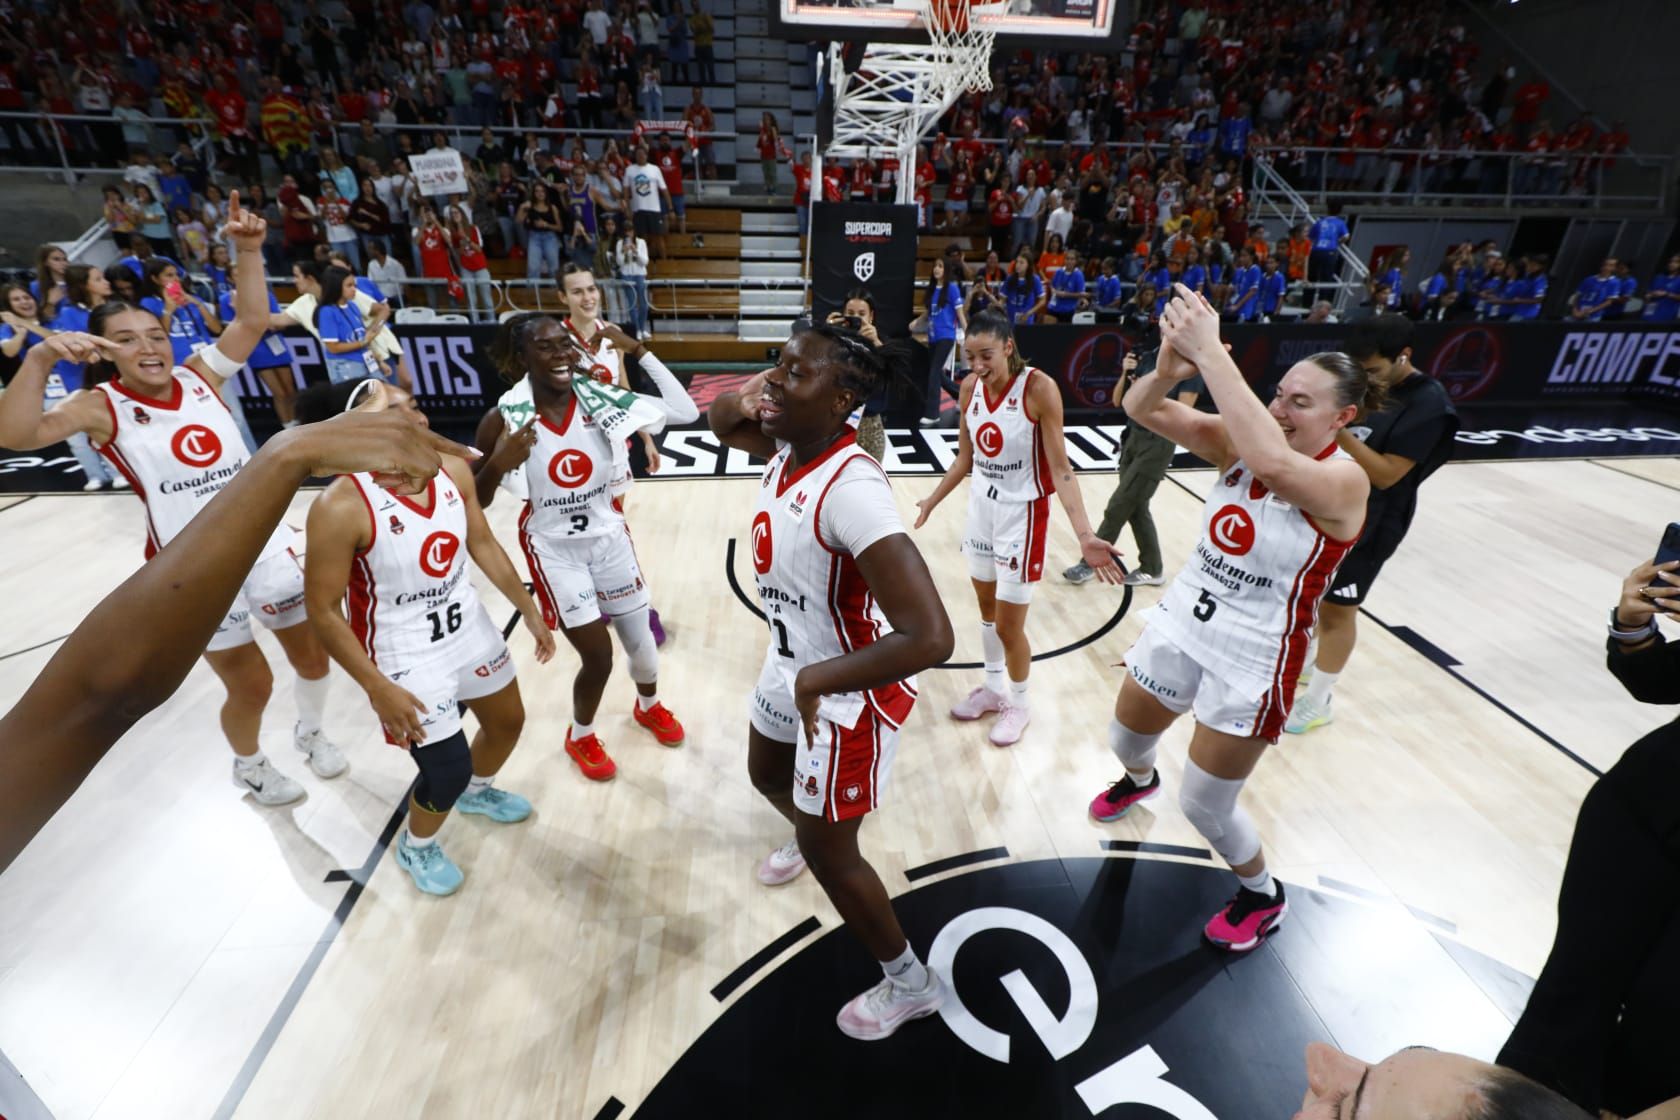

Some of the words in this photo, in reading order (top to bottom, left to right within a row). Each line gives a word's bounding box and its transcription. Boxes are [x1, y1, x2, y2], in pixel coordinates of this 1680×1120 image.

[845, 222, 892, 236] SUPERCOPA
[1193, 588, 1217, 622] 5
[426, 602, 462, 643] 16
[1133, 665, 1177, 698] Silken
